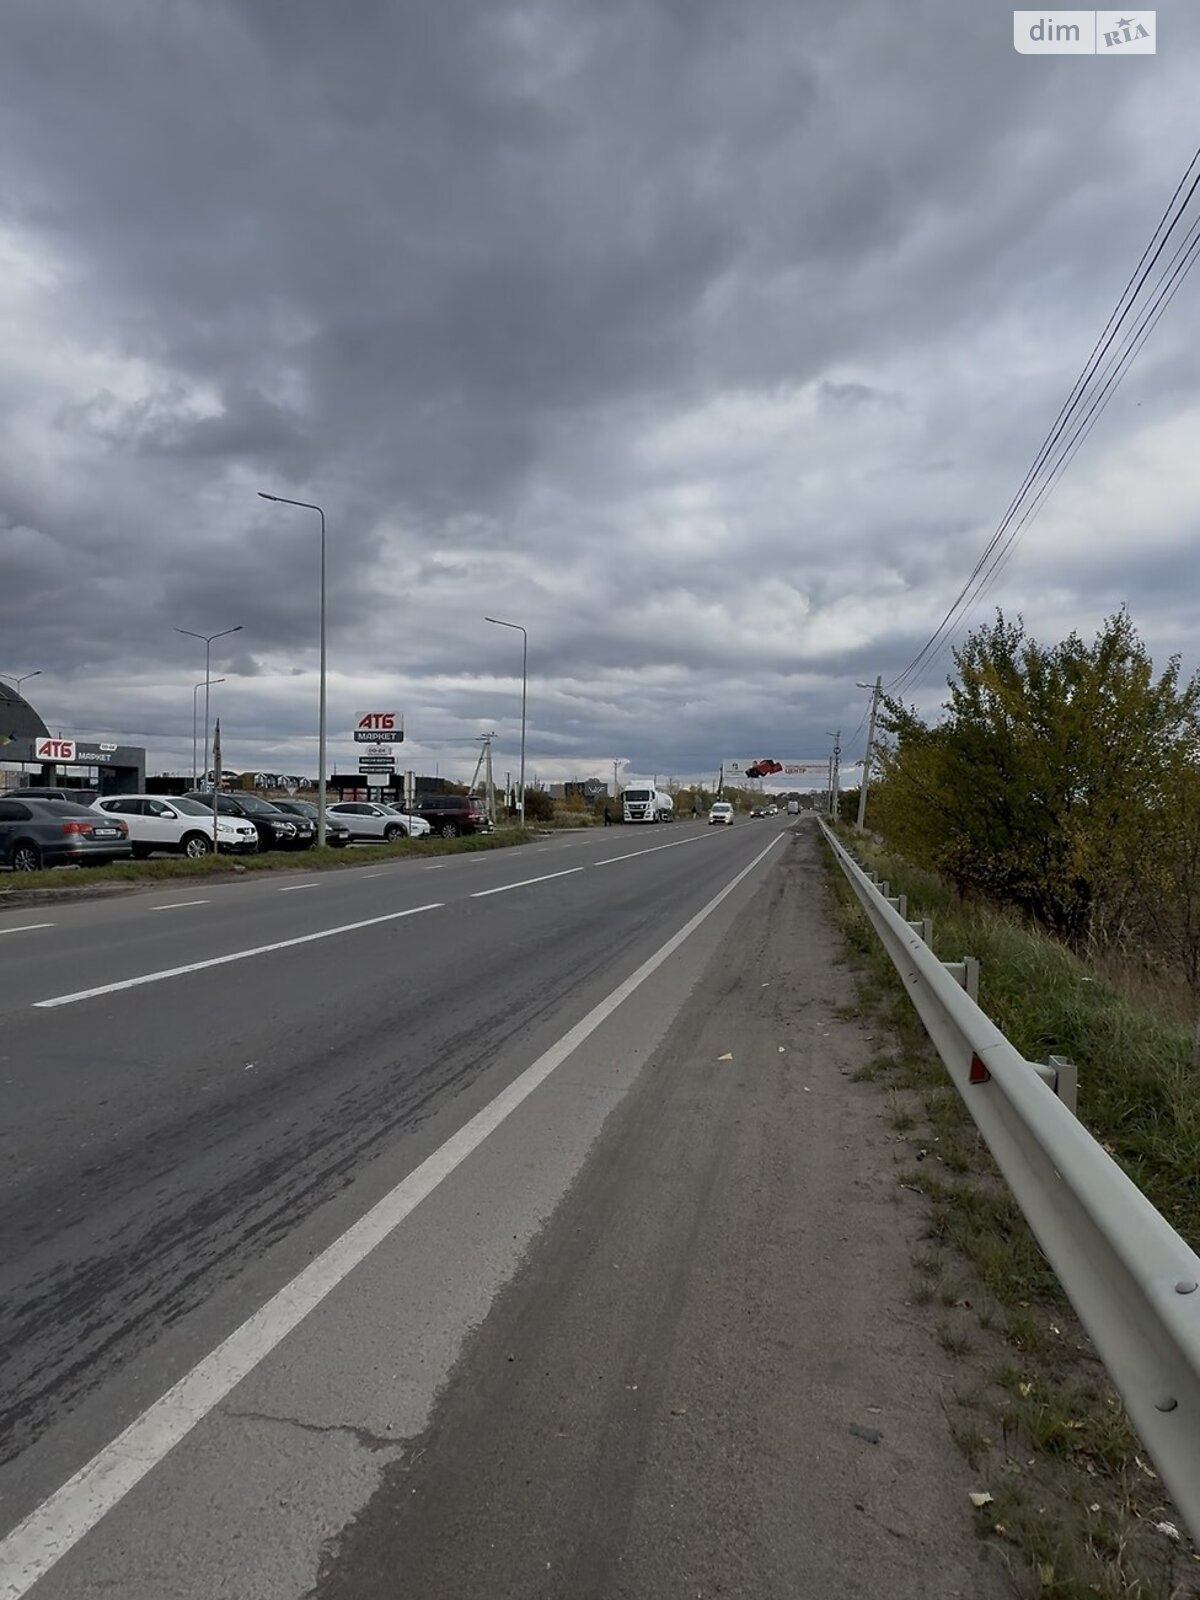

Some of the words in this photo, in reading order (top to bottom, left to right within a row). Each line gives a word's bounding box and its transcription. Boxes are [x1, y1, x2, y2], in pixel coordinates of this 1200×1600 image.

[358, 712, 396, 729] АТБ
[357, 732, 397, 741] МАРКЕТ
[39, 740, 74, 758] АТБ
[78, 752, 112, 762] МАРКЕТ
[784, 767, 807, 775] ЦЕНТР
